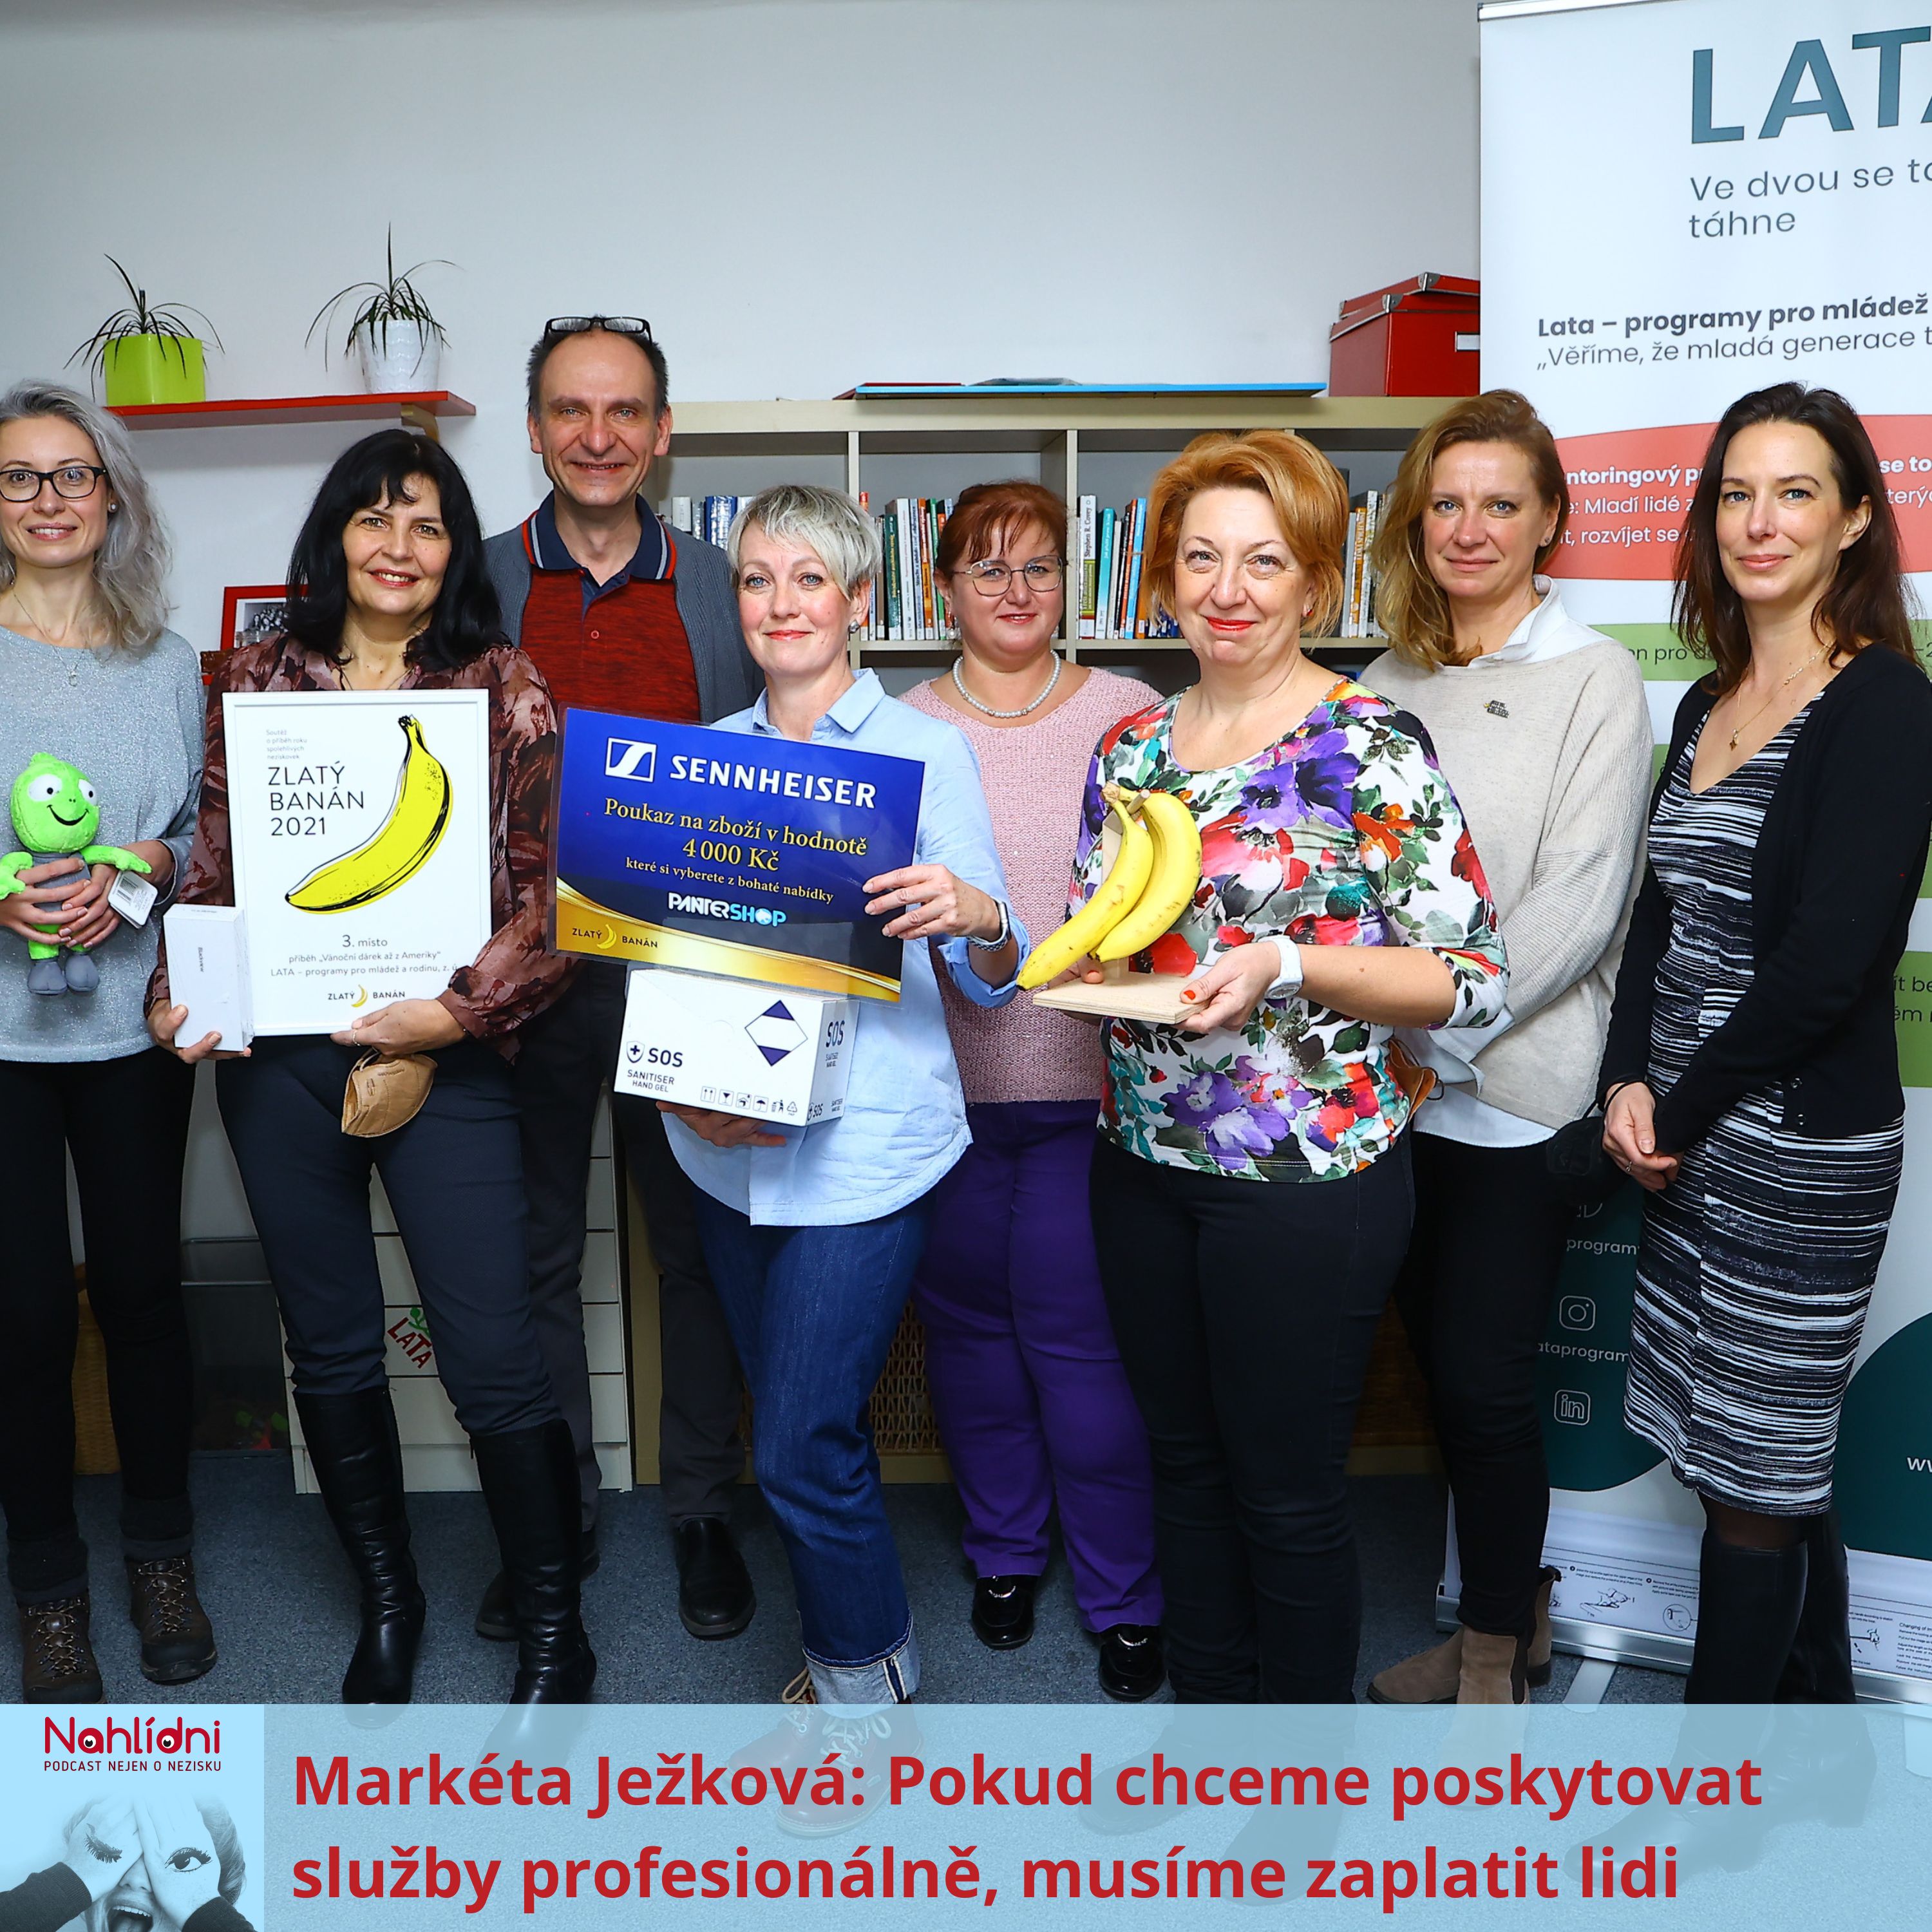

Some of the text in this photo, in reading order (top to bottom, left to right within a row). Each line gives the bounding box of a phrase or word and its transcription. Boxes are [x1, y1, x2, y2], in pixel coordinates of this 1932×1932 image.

[1692, 26, 1932, 144] LAT
[1690, 176, 1734, 201] Ve
[1747, 171, 1838, 197] dvou
[1853, 166, 1894, 188] se
[1689, 211, 1795, 238] táhne
[1539, 316, 1594, 337] Lata
[1625, 310, 1762, 339] programy
[1768, 305, 1815, 331] pro
[1823, 292, 1928, 320] mládež
[1651, 341, 1679, 361] že
[1687, 334, 1773, 359] mladá
[1783, 330, 1915, 361] generace
[1565, 464, 1681, 488] ntoringový
[1879, 459, 1905, 474] se
[1908, 456, 1932, 473] to
[1084, 507, 1093, 525] Covey
[1584, 495, 1640, 515] Mladí
[1643, 495, 1681, 513] lidé
[1084, 534, 1092, 558] Stephen
[1581, 526, 1651, 548] rozvíjet
[1656, 528, 1680, 542] se
[1654, 648, 1688, 665] pro
[268, 761, 345, 786] ZLATÝ
[669, 755, 876, 810] SENNHEISER
[270, 786, 364, 811] BANÁN
[270, 817, 325, 836] 2021
[604, 797, 868, 857] Poukaz na zboží v hodnotě
[748, 846, 781, 872] Kč
[625, 857, 834, 904] které si vyberete z bohaté nabídky
[668, 892, 788, 927] PANTERSHOP
[342, 934, 388, 948] 3. místo
[571, 925, 659, 949] ZLATÝ BANÁN
[270, 968, 295, 976] LATA
[305, 969, 348, 977] programy
[350, 967, 366, 976] pro
[368, 965, 399, 974] mládež
[289, 954, 316, 965] příběh
[328, 990, 406, 1000] ZLATÝ BANÁN
[825, 1019, 845, 1048] SOS
[647, 1047, 684, 1068] SOS
[627, 1069, 675, 1086] SANITISER
[632, 1079, 669, 1093] HAND GEL
[1566, 1238, 1640, 1256] program
[387, 1317, 433, 1369] LATA
